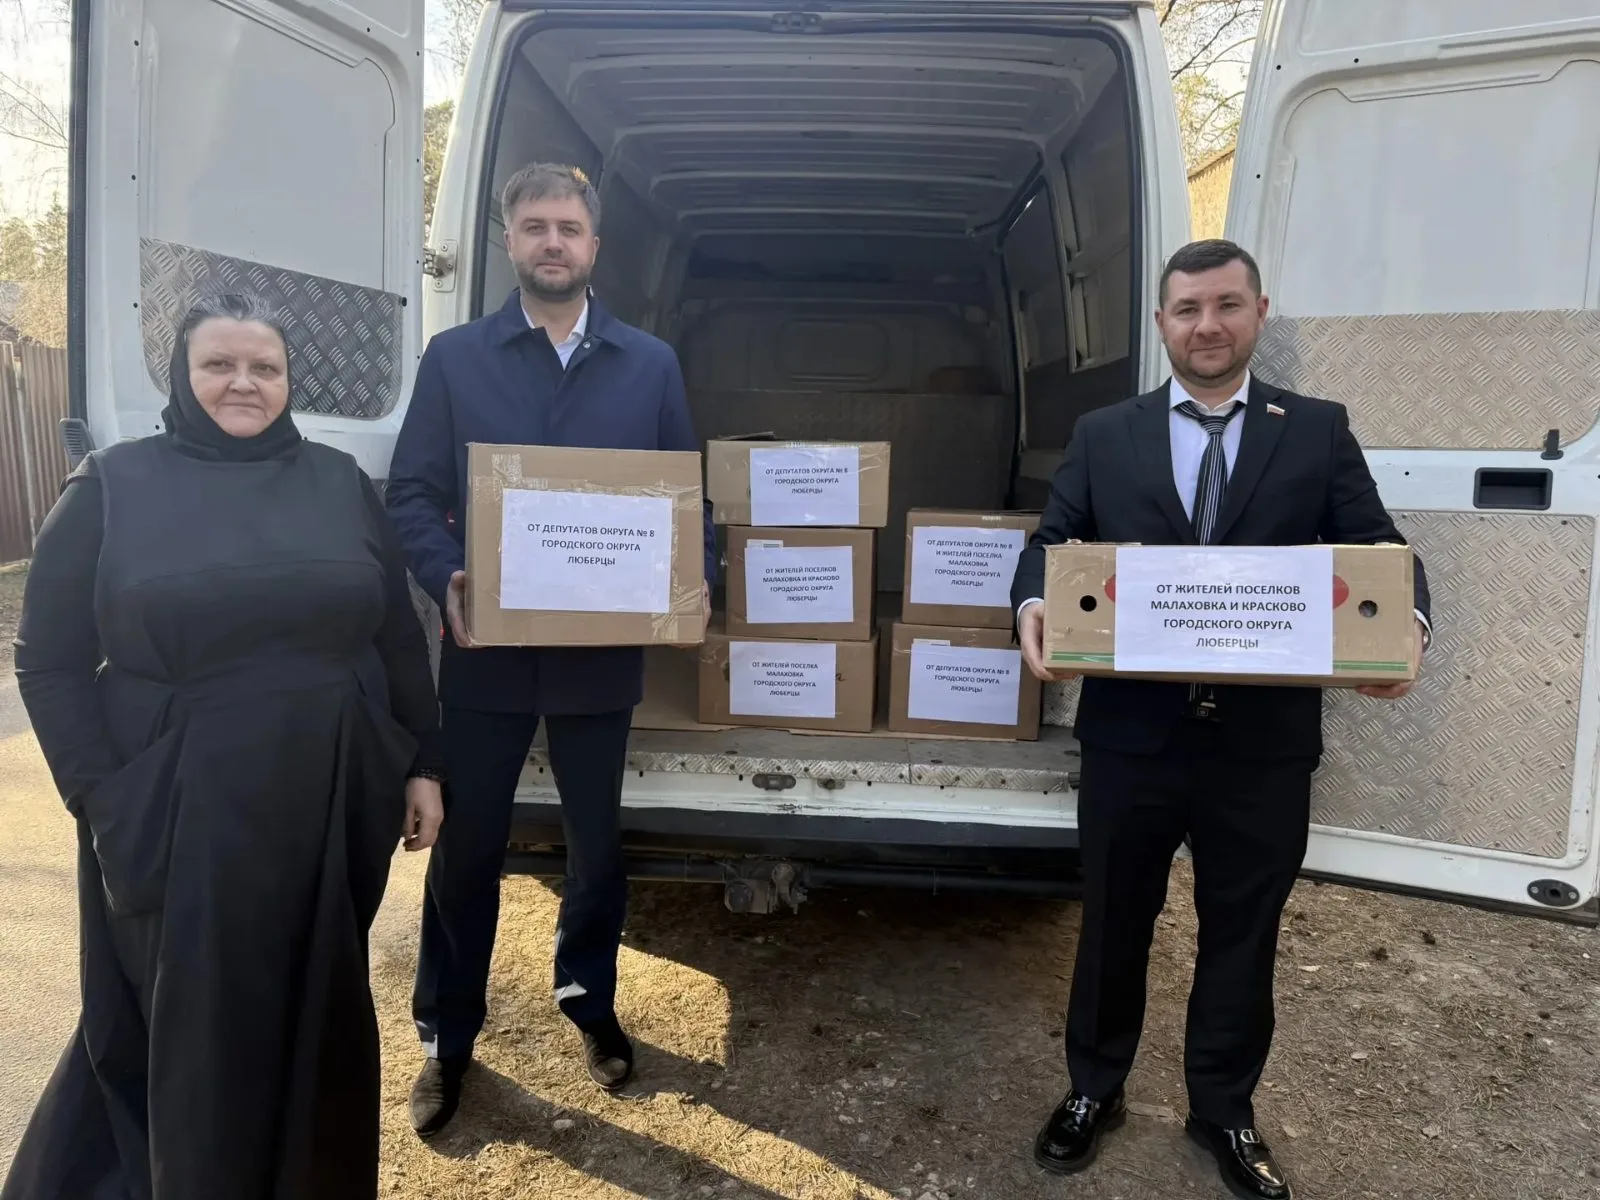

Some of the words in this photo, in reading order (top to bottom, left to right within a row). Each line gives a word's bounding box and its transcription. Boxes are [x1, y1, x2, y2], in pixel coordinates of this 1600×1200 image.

[528, 524, 540, 532] ОТ
[543, 524, 598, 535] ДЕПУТАТОВ
[600, 527, 635, 536] ОКРУГА
[636, 529, 647, 537] №
[542, 540, 604, 551] ГОРОДСКОГО
[606, 542, 640, 552] ОКРУГА
[942, 550, 972, 558] ЖИТЕЛЕЙ
[567, 556, 615, 566] ЛЮБЕРЦЫ
[1156, 584, 1172, 595] ОТ
[1175, 582, 1233, 596] ЖИТЕЛЕЙ
[1235, 585, 1300, 596] ПОСЕЛКОВ
[1151, 600, 1227, 612] МАЛАХОВКА
[1230, 601, 1239, 612] И
[1242, 601, 1306, 612] КРАСКОВО
[1164, 619, 1243, 631] ГОРОДСКОГО
[1246, 619, 1292, 631] ОКРУГА
[1196, 637, 1258, 650] ЛЮБЕРЦЫ
[935, 665, 971, 673] ДЕПУТАТОВ
